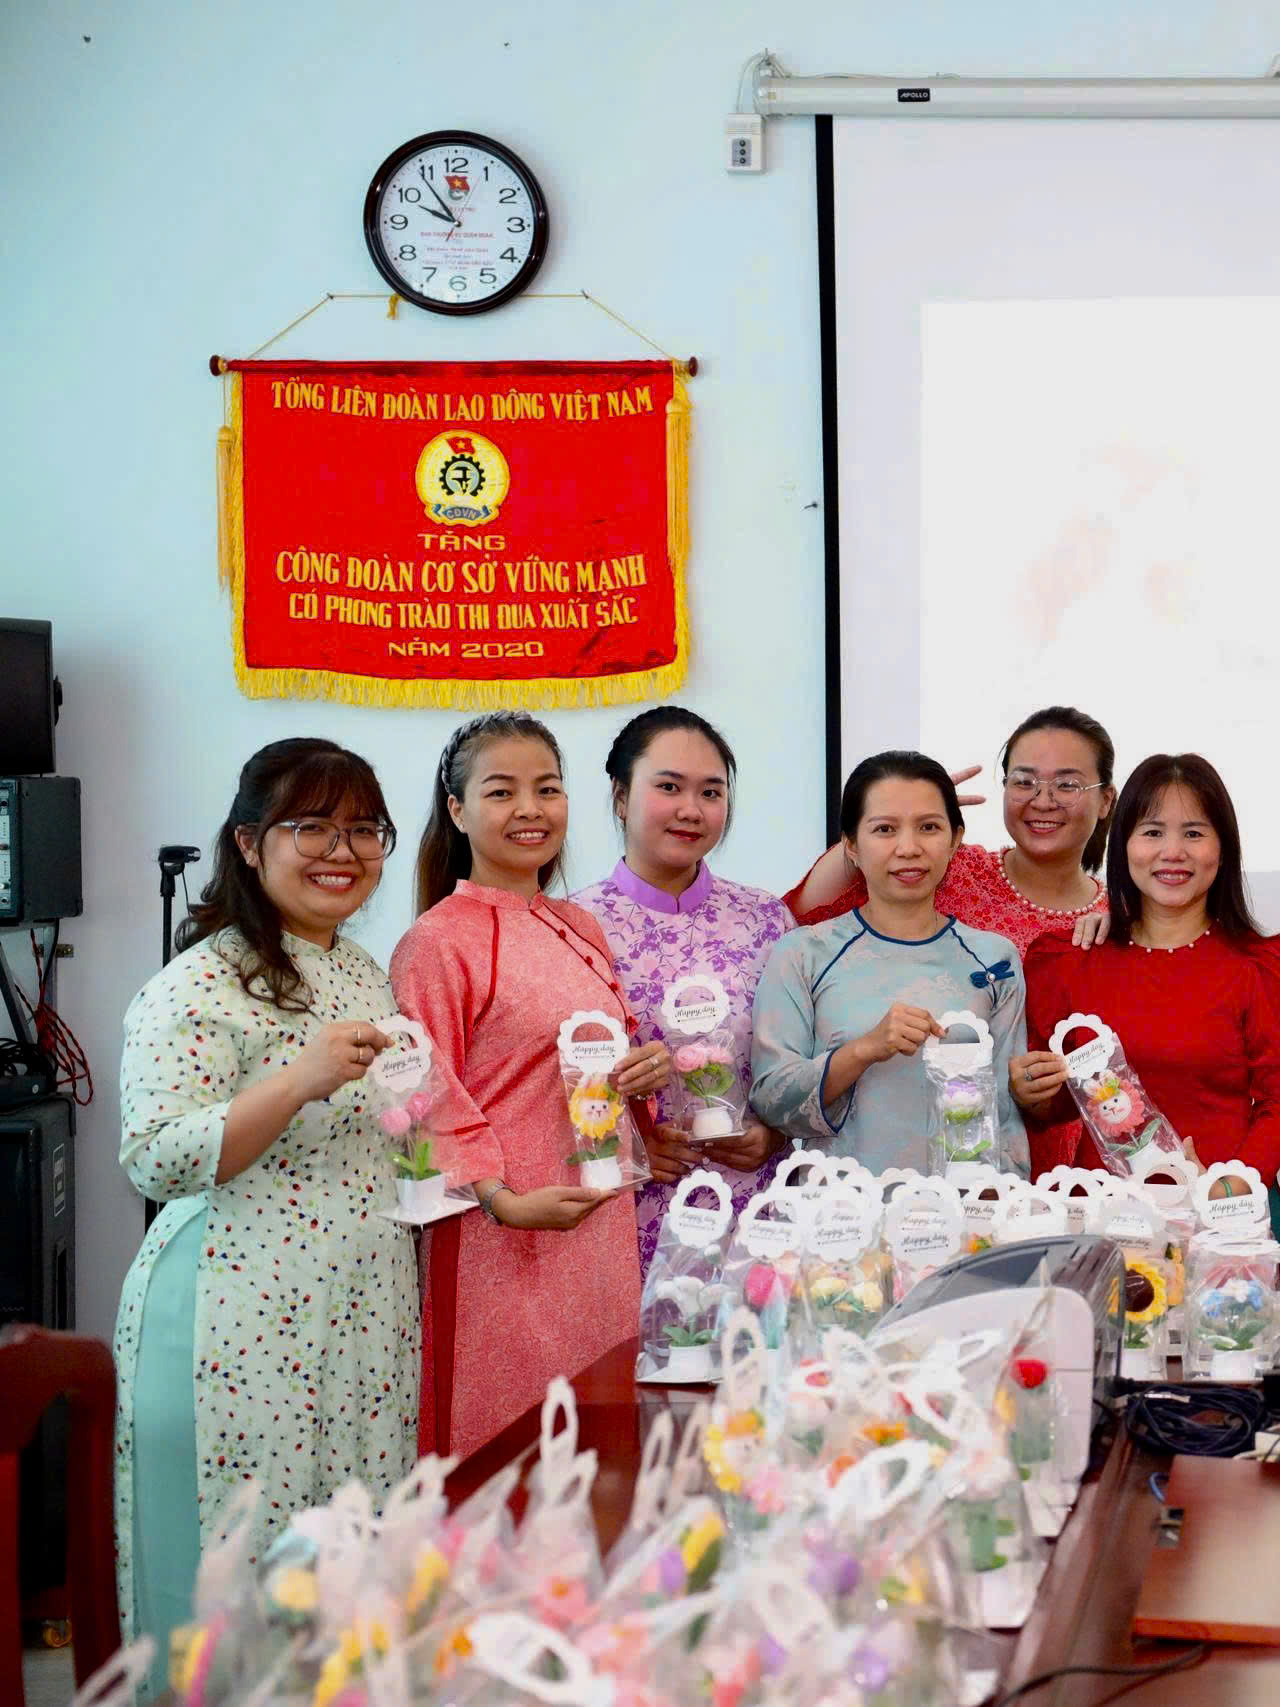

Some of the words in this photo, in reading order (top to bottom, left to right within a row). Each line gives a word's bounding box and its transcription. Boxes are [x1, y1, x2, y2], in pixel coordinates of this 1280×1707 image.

[444, 157, 469, 173] 12
[483, 166, 489, 181] 1
[397, 187, 421, 203] 10
[498, 188, 518, 204] 2
[390, 213, 408, 230] 9
[506, 216, 526, 233] 3
[399, 244, 417, 261] 8
[499, 247, 518, 263] 4
[422, 267, 437, 282] 7
[479, 268, 497, 284] 5
[450, 275, 467, 291] 6
[271, 376, 326, 410] TỔNG
[330, 384, 378, 417] LIÊN
[382, 387, 439, 420] ĐOÀN
[443, 392, 486, 422] LAO
[490, 388, 545, 424] ĐỘNG
[549, 388, 602, 424] VIỆT
[605, 385, 654, 418] NAM
[416, 530, 506, 552] TẶNG
[275, 545, 341, 585] CÔNG
[346, 554, 415, 593] ĐOÀN
[421, 560, 457, 593] CƠ
[461, 553, 499, 594] SỞ
[503, 553, 570, 593] VỮNG
[576, 554, 648, 597] MẠNH
[288, 588, 319, 620] CÓ
[325, 594, 393, 629] PHONG
[397, 597, 451, 630] TRÀO
[455, 603, 491, 630] THI
[497, 603, 537, 630] ĐUA
[539, 598, 591, 629] XUẤT
[595, 593, 640, 628] SẮC
[388, 636, 450, 657] NĂM
[461, 640, 545, 659] 2020
[675, 1008, 701, 1018] Happy
[701, 1005, 716, 1015] day
[572, 1044, 600, 1055] Happy
[600, 1043, 616, 1054] day
[1208, 1202, 1238, 1214] Happy
[1238, 1199, 1255, 1210] day
